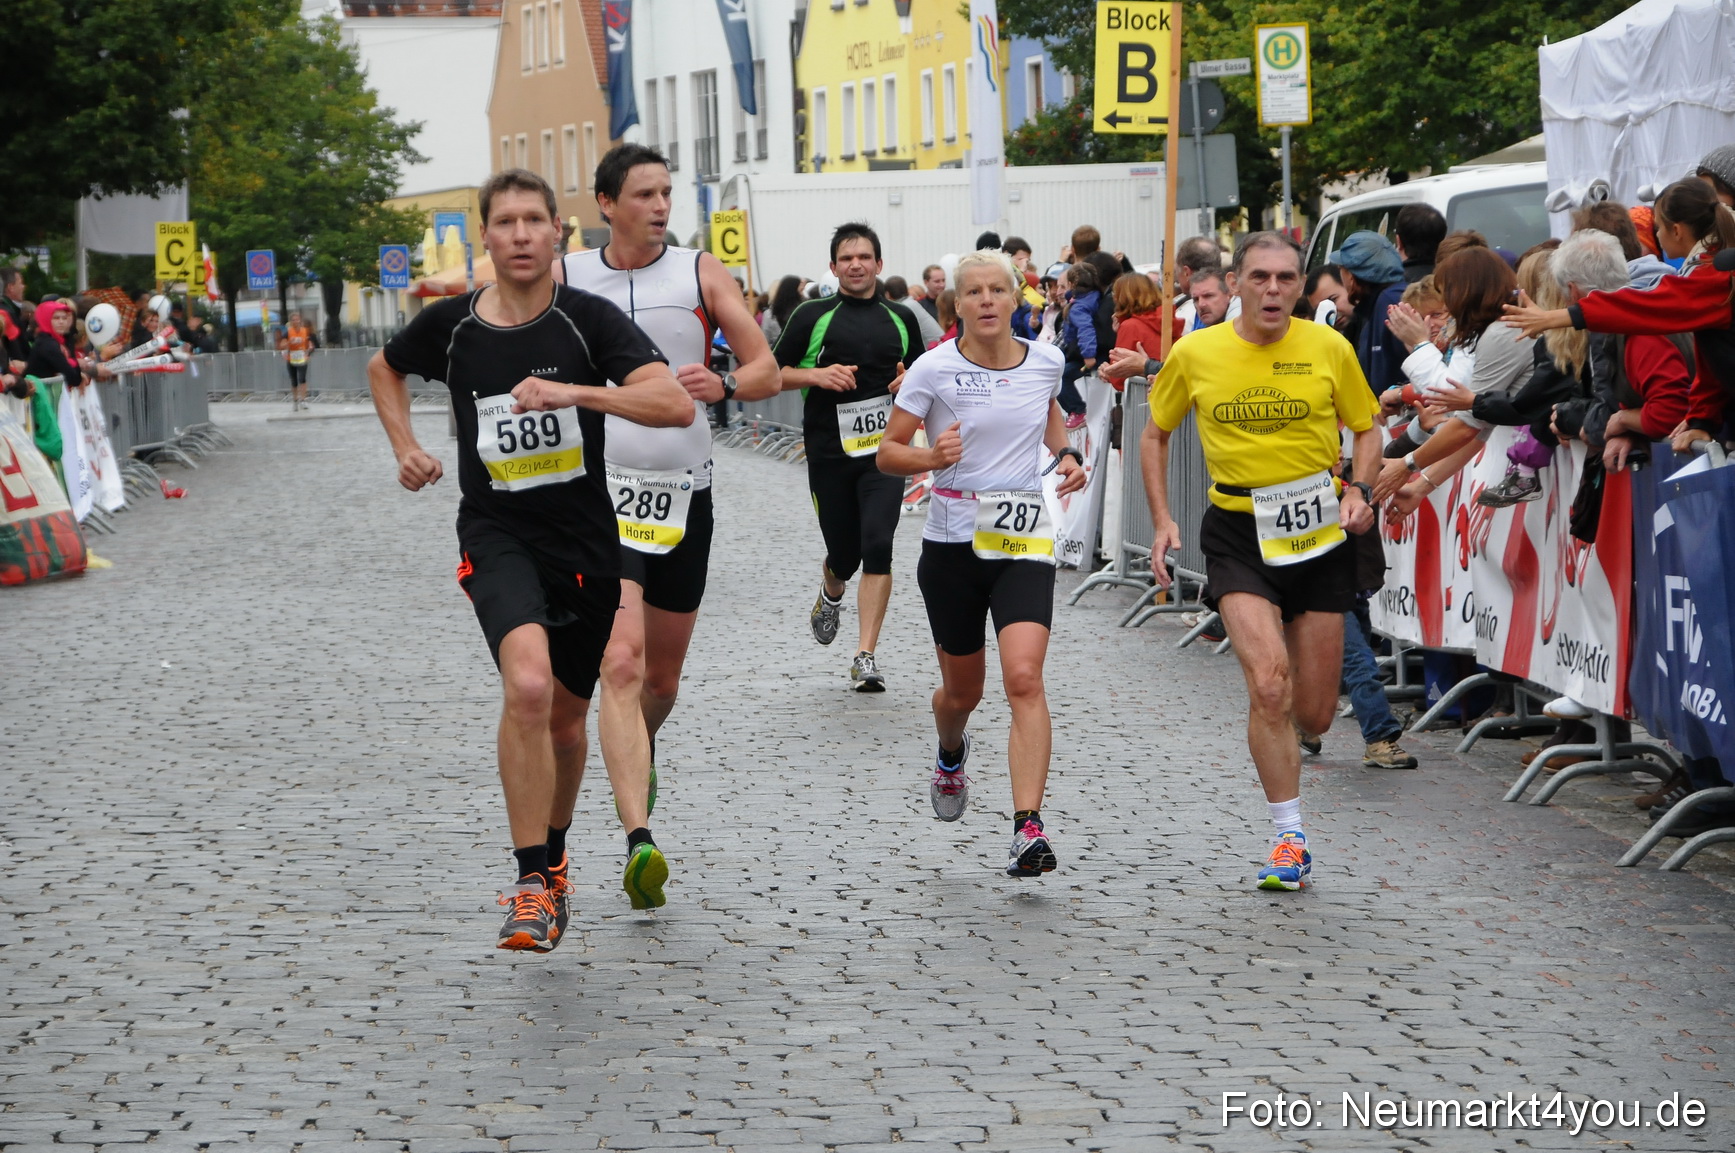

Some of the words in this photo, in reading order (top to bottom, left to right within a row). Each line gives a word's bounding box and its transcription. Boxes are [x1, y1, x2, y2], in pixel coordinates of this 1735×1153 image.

[1106, 7, 1171, 31] Block
[846, 41, 873, 71] HOTEL
[1273, 39, 1292, 61] H
[1117, 41, 1158, 104] B
[1200, 63, 1222, 73] Ulmer
[1224, 61, 1247, 72] Gasse
[714, 211, 744, 224] Block
[159, 223, 189, 235] Block
[720, 226, 740, 255] C
[165, 238, 185, 266] C
[251, 276, 272, 286] TAXI
[383, 274, 406, 285] TAXI
[1235, 388, 1287, 404] PIZZERIA
[479, 405, 508, 418] PARTL
[838, 407, 859, 415] PARTL
[1224, 401, 1299, 420] FRANCESCO
[852, 410, 887, 434] 468
[496, 412, 562, 454] 589
[501, 458, 564, 479] Reiner
[605, 470, 634, 484] PARTL
[636, 477, 678, 489] Neumarkt
[1254, 492, 1285, 504] PARTL
[1286, 482, 1322, 499] Neumarkt
[615, 487, 672, 521] 289
[1275, 494, 1323, 533] 451
[993, 500, 1042, 533] 287
[625, 524, 655, 541] Horst
[1001, 538, 1028, 553] Petra
[1291, 536, 1317, 551] Hans
